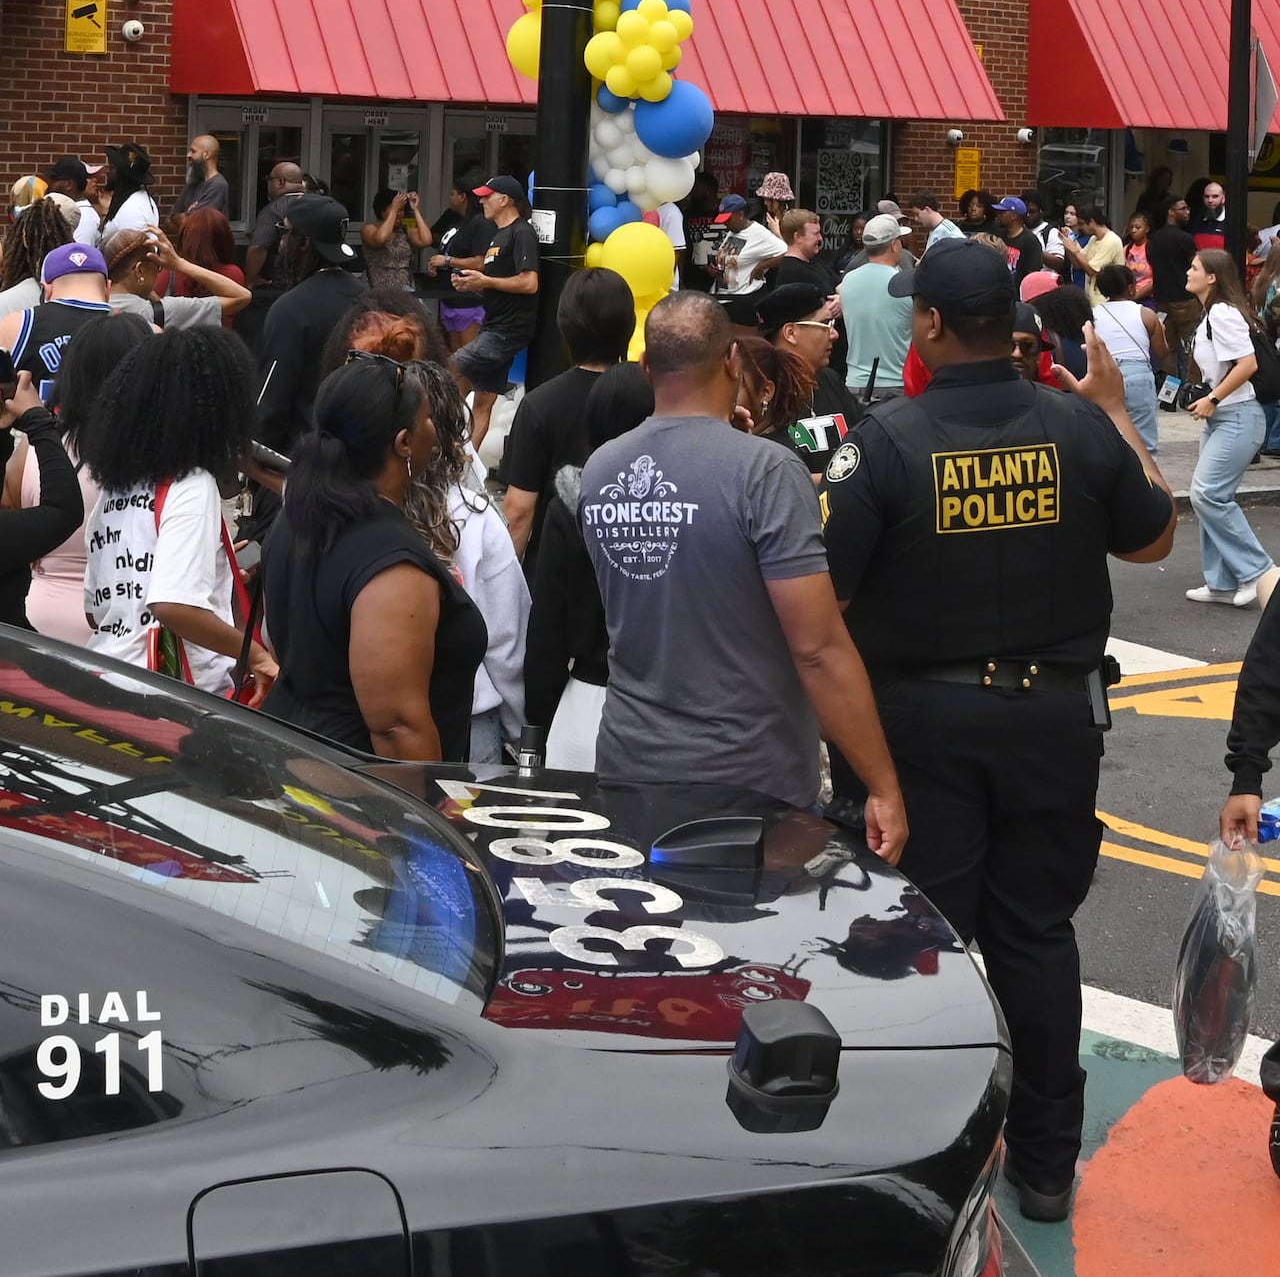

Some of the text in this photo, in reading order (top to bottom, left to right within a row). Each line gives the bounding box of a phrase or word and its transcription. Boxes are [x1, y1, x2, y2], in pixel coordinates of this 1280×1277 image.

[242, 107, 267, 115] ORDER
[245, 115, 265, 123] HERE
[942, 450, 1055, 491] ATLANTA
[584, 502, 699, 526] STONECREST
[942, 487, 1055, 529] POLICE
[596, 526, 680, 539] DISTILLERY
[647, 555, 662, 563] 2017
[435, 779, 725, 969] 35801
[41, 990, 162, 1026] DIAL
[36, 1030, 163, 1101] 911
